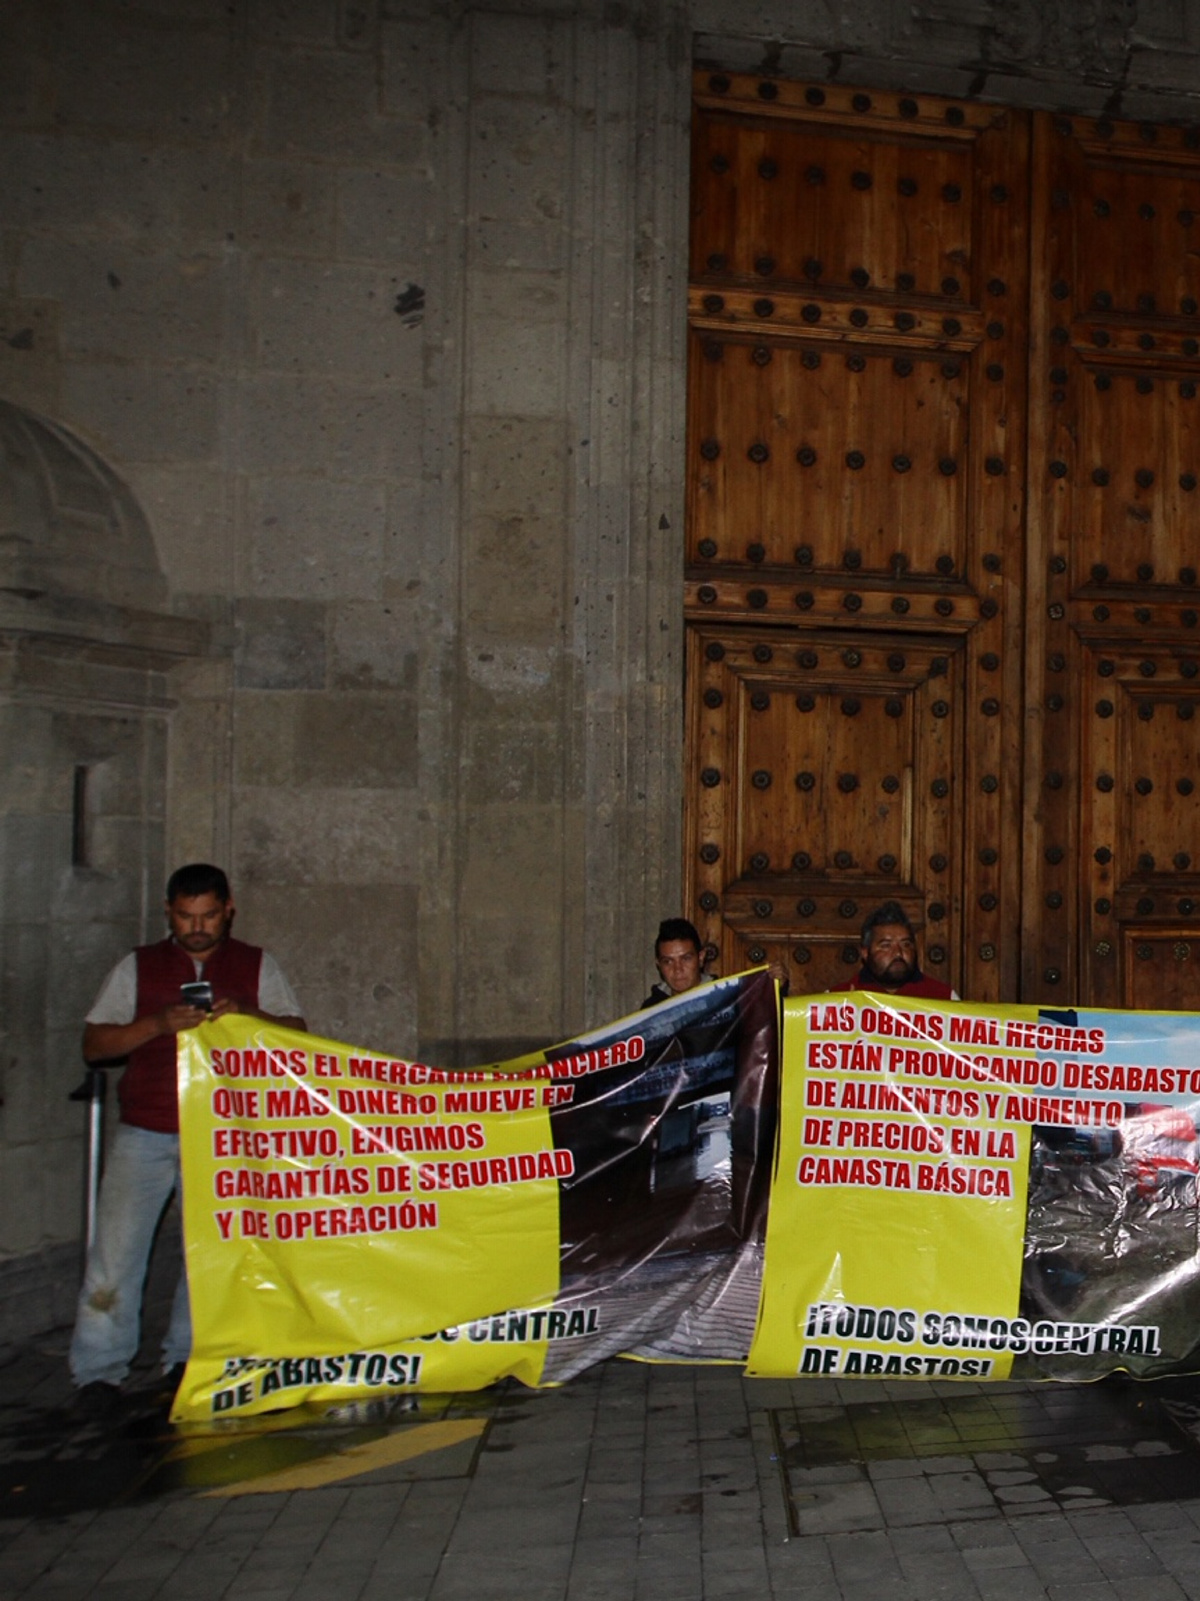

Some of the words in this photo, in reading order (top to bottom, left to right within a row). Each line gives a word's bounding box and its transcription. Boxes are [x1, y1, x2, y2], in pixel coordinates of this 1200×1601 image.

[809, 1004, 856, 1034] LAS
[860, 1007, 944, 1044] OBRAS
[949, 1018, 1002, 1047] MAL
[1006, 1021, 1105, 1055] HECHAS
[210, 1046, 307, 1078] SOMOS
[314, 1054, 345, 1078] EL
[807, 1039, 885, 1073] ESTÁN
[887, 1048, 1058, 1089] PROVOCANDO
[212, 1090, 260, 1120] QUE
[266, 1087, 333, 1119] MÁS
[338, 1088, 437, 1117] DINERO
[443, 1085, 536, 1114] MUEVE
[541, 1084, 575, 1108] EN
[806, 1080, 839, 1108] DE
[839, 1081, 983, 1120] ALIMENTOS
[985, 1093, 1002, 1119] Y
[1004, 1095, 1126, 1129] AUMENTO
[213, 1127, 346, 1160] EFECTIVO,
[351, 1122, 485, 1155] EXIGIMOS
[803, 1118, 834, 1147] DE
[836, 1119, 944, 1155] PRECIOS
[950, 1128, 981, 1157] EN
[985, 1132, 1017, 1160] LA
[215, 1164, 370, 1200] GARANTÍAS
[376, 1165, 412, 1194] DE
[418, 1149, 575, 1191] SEGURIDAD
[798, 1156, 914, 1190] CANASTA
[917, 1159, 1012, 1198] BÁSICA
[217, 1213, 238, 1241] Y
[241, 1210, 271, 1238] DE
[274, 1199, 438, 1239] OPERACIÓN
[468, 1307, 600, 1342] CENTRAL
[805, 1304, 915, 1343] ¡TODOS
[922, 1313, 1030, 1355] SOMOS
[1032, 1322, 1162, 1357] CENTRAL
[211, 1378, 253, 1414] DE
[260, 1353, 424, 1398] ABASTOS!
[799, 1347, 837, 1376] DE
[841, 1351, 993, 1378] ABASTOS!
